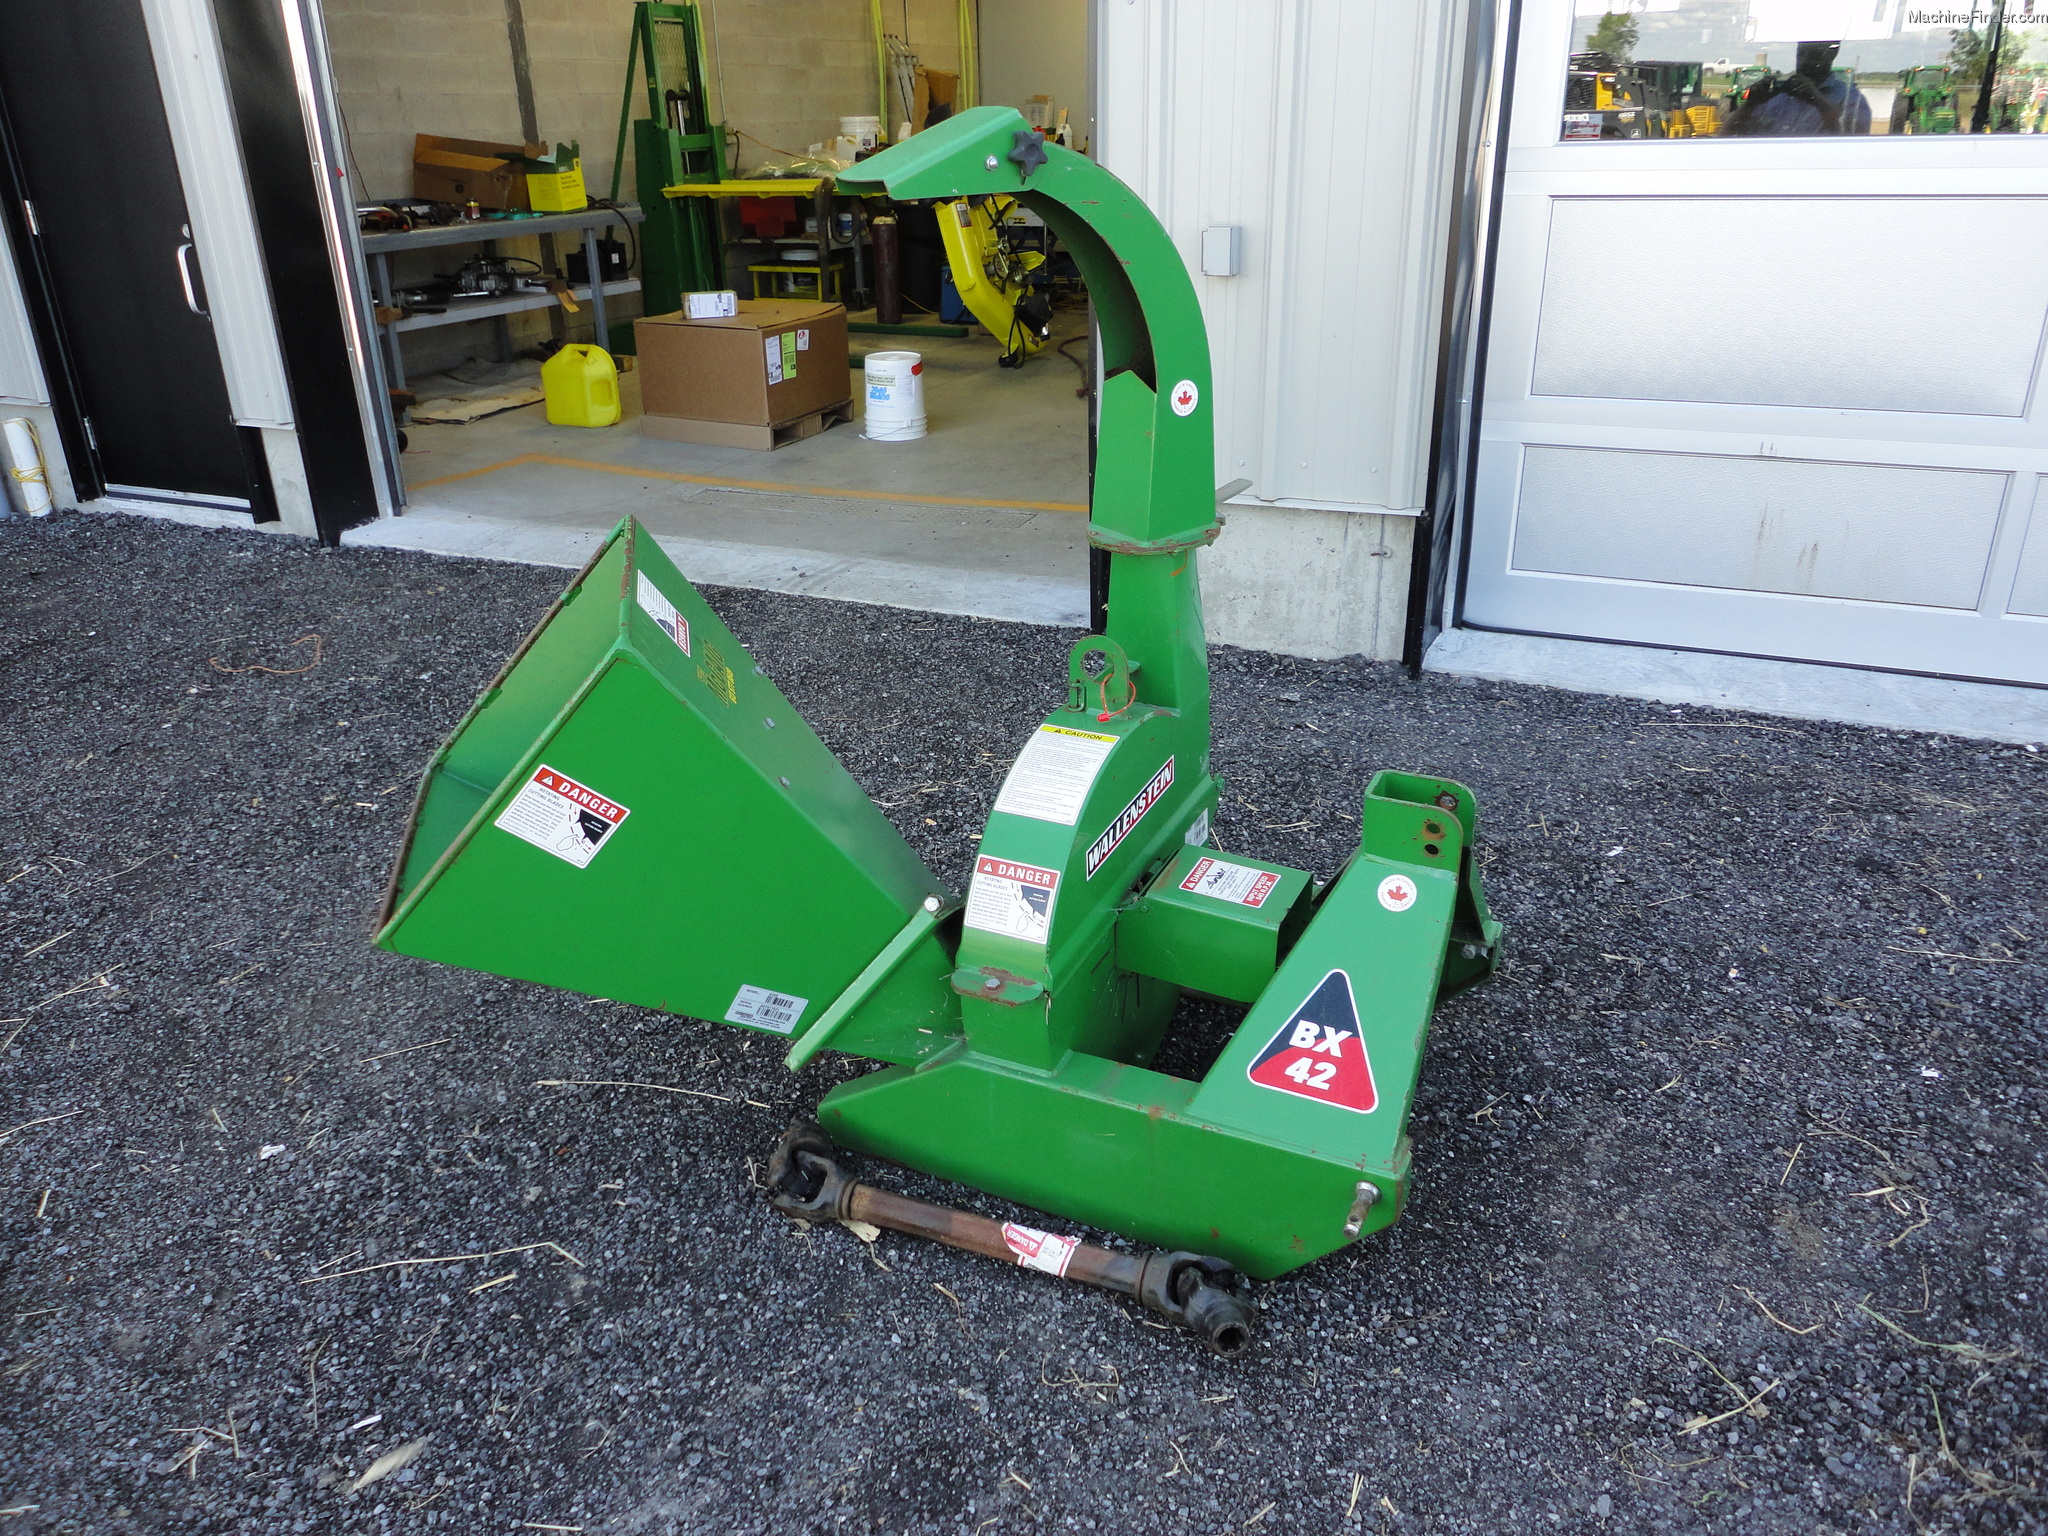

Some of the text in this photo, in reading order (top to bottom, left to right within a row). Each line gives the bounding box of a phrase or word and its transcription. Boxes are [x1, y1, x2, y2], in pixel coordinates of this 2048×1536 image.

[1065, 730, 1103, 740] CAUTION
[558, 782, 619, 819] DANGER
[1088, 762, 1173, 867] WALLENSTEIN
[998, 864, 1051, 885] DANGER
[1193, 860, 1212, 882] DANGER
[1288, 1019, 1353, 1058] BX
[1284, 1056, 1337, 1091] 42
[1006, 1229, 1030, 1247] DANGER
